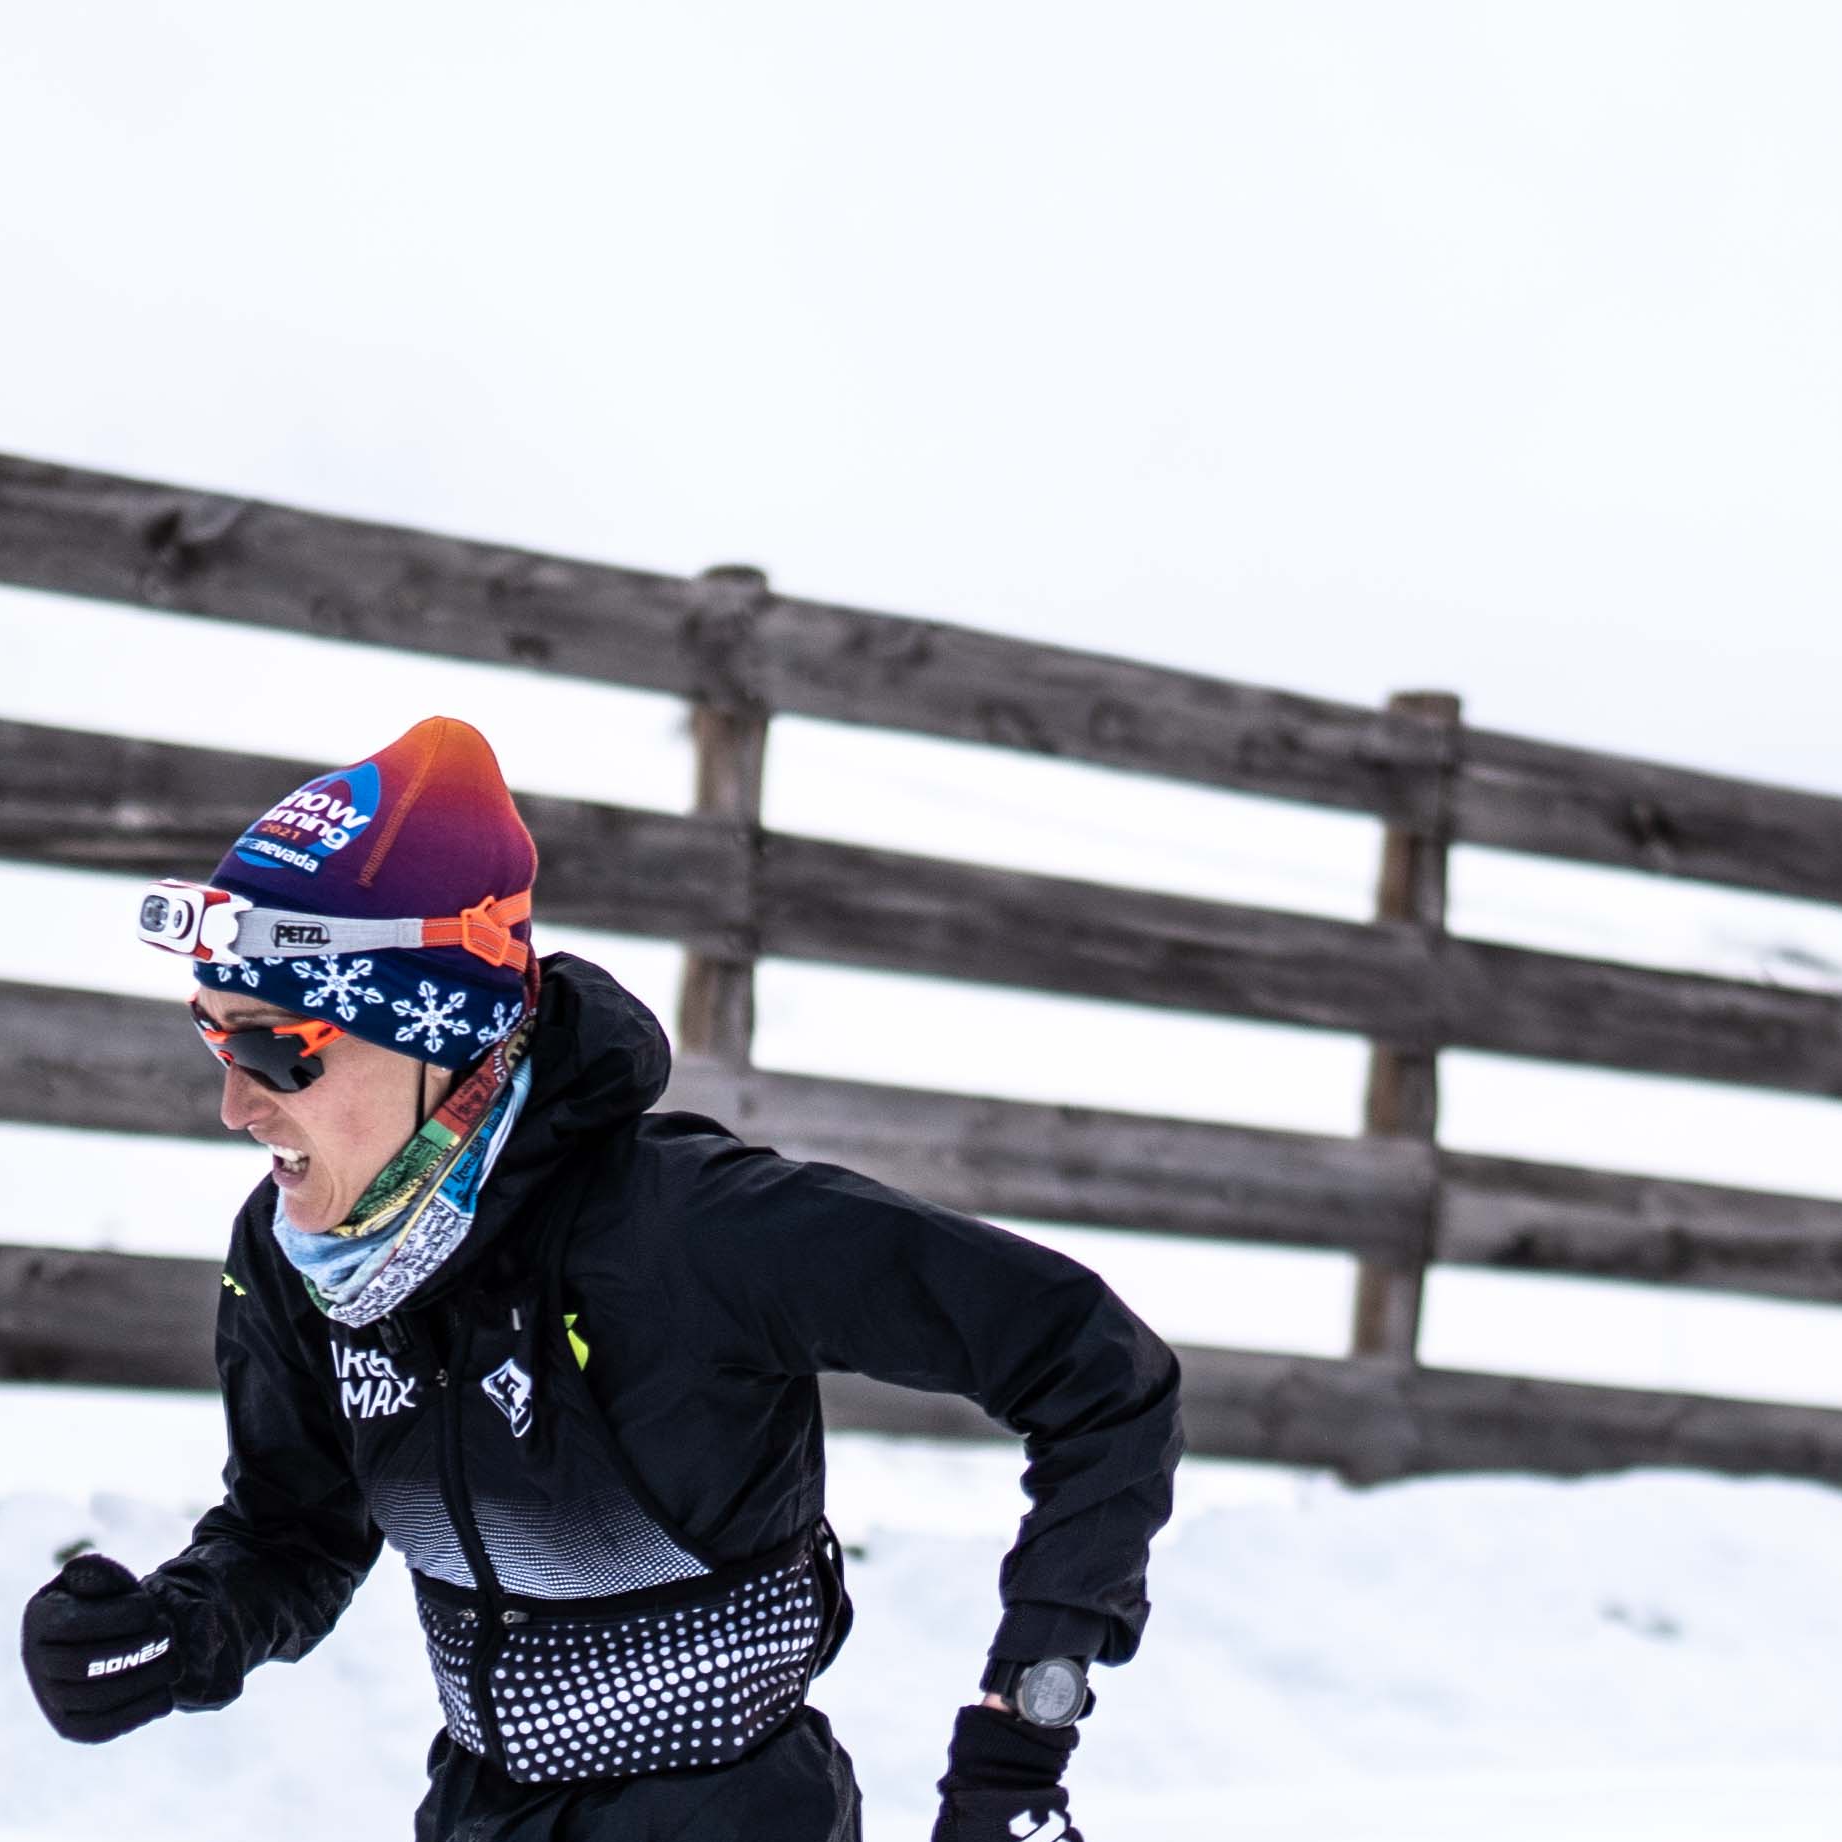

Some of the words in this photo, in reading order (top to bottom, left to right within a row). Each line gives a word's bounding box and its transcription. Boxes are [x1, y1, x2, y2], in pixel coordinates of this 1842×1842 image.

[287, 791, 371, 829] now
[261, 823, 302, 840] 2021
[262, 809, 350, 850] unning
[274, 924, 331, 947] PETZL
[341, 1377, 416, 1418] MAX
